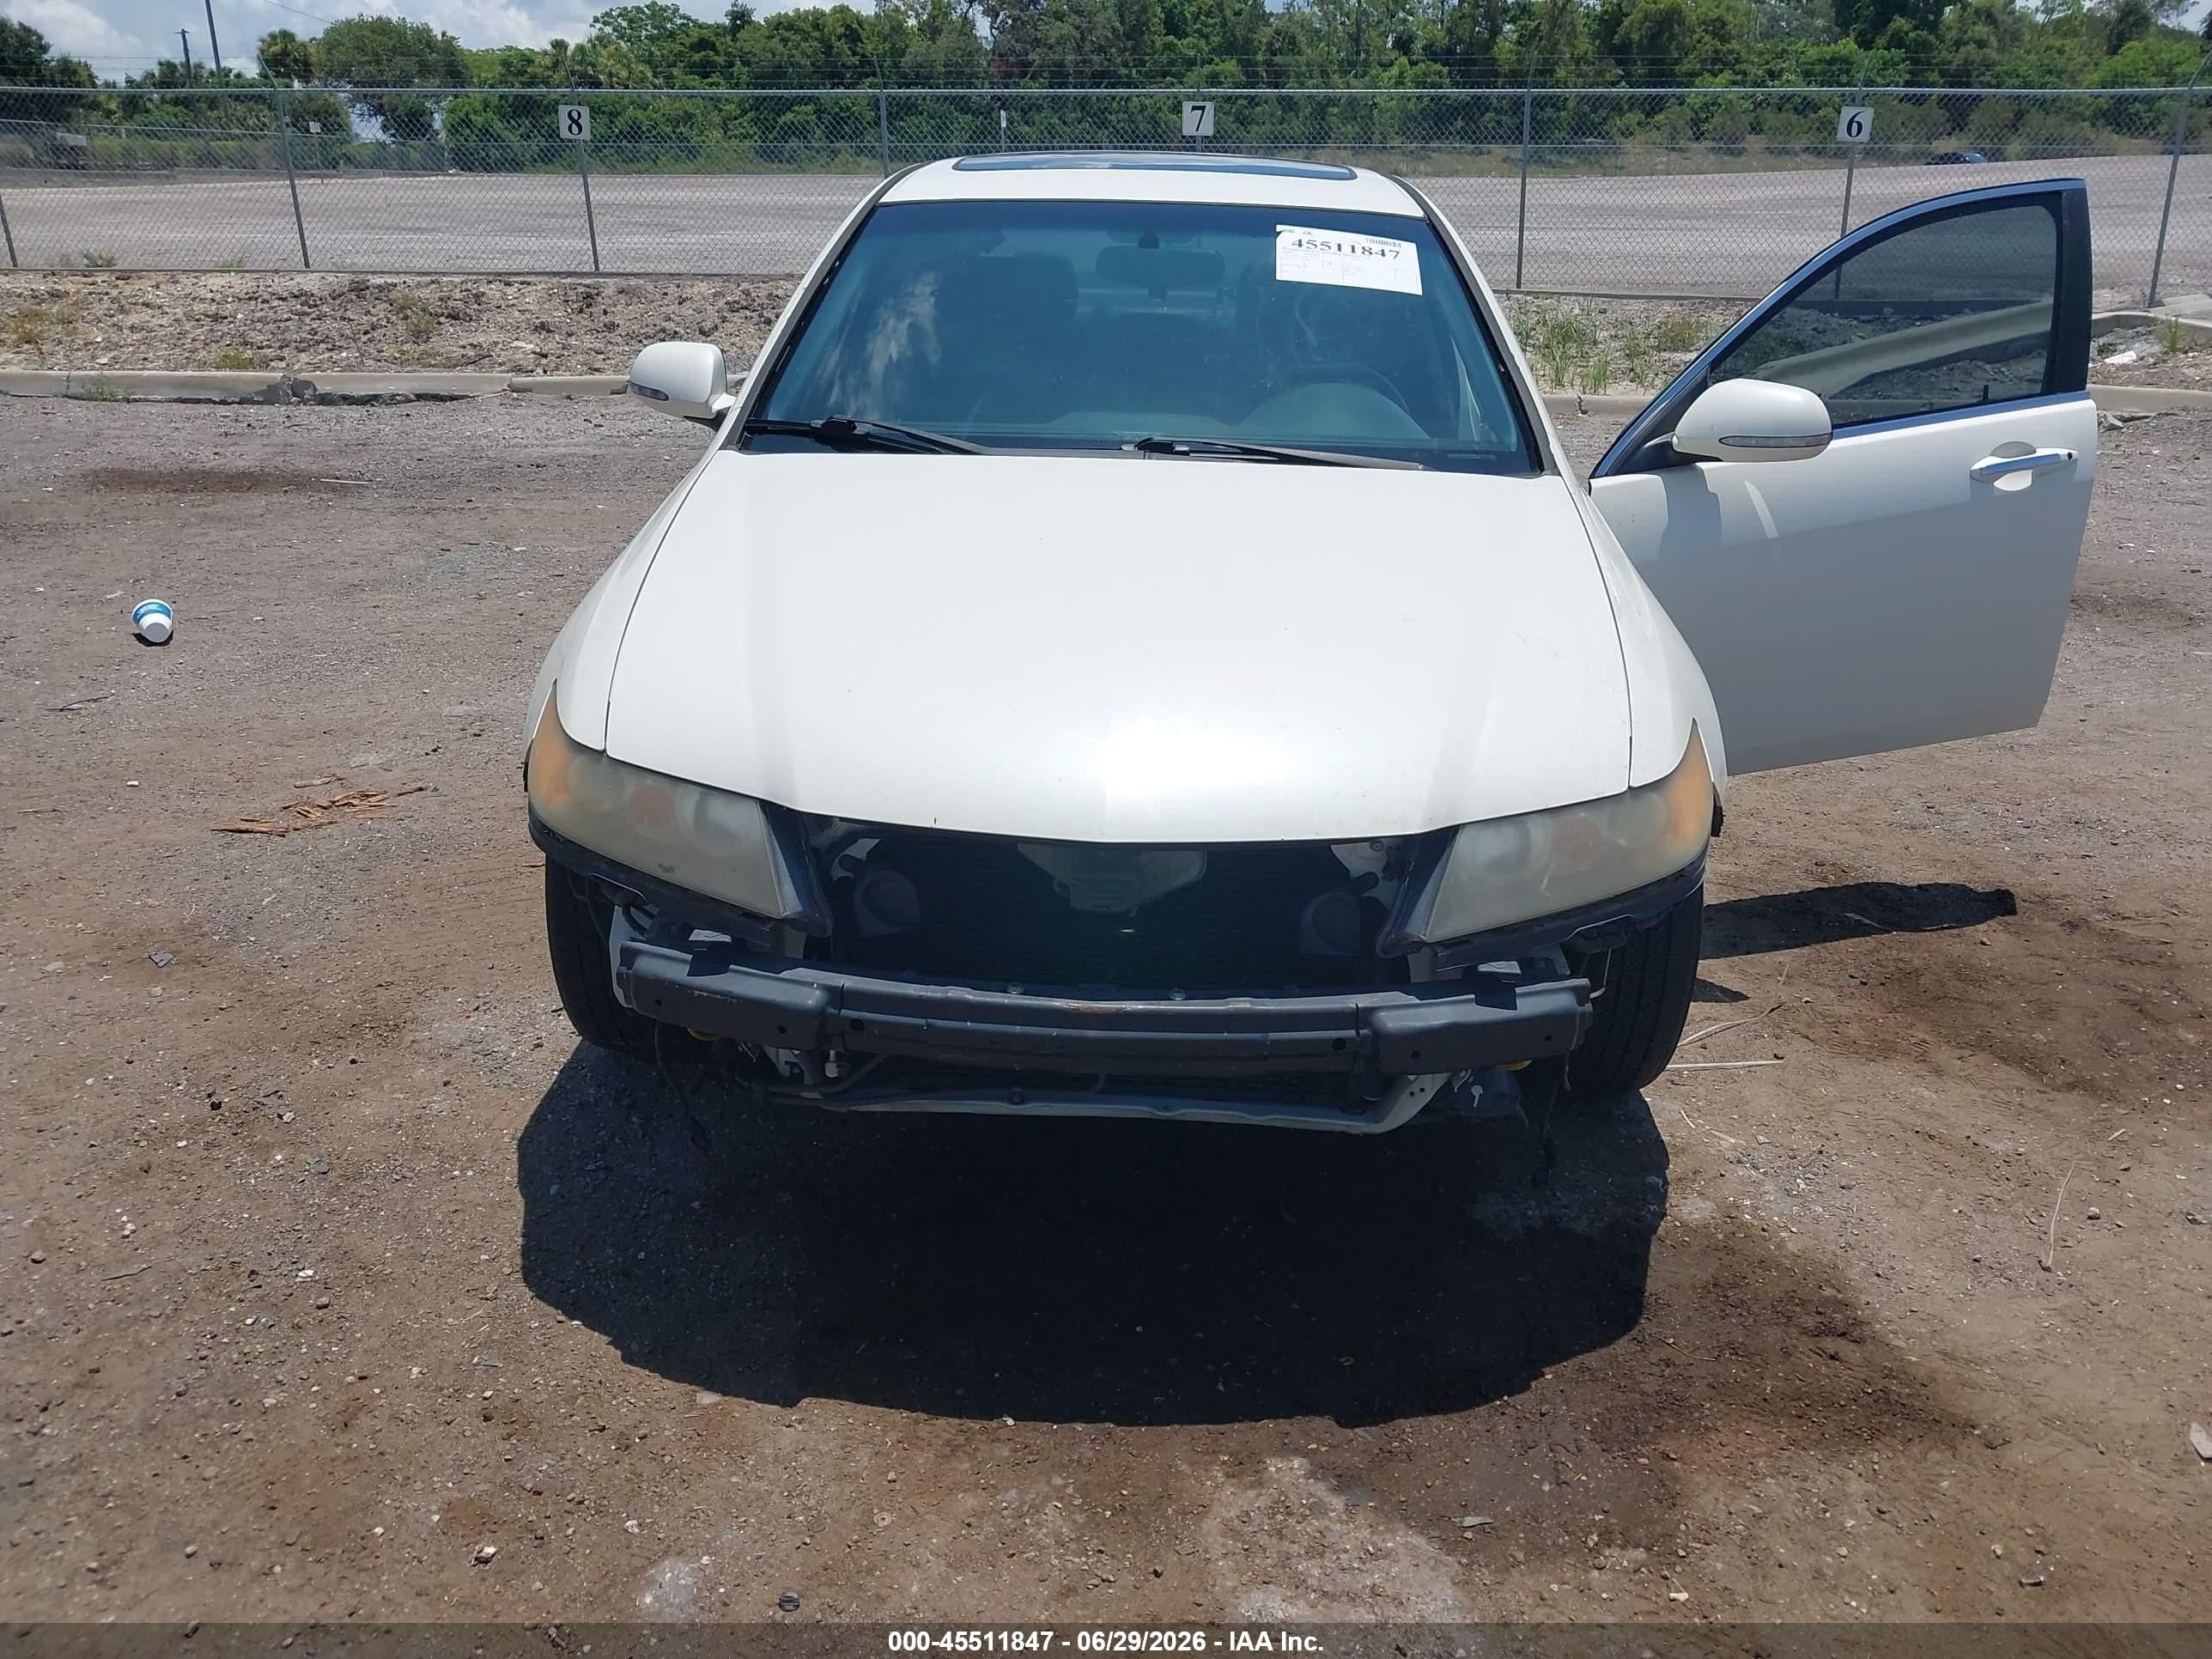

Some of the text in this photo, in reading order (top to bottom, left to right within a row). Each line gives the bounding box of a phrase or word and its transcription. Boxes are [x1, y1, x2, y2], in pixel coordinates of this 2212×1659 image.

[568, 109, 583, 136] 8
[1190, 105, 1206, 132] 7
[1846, 110, 1865, 138] 6
[1291, 238, 1401, 259] 45511847
